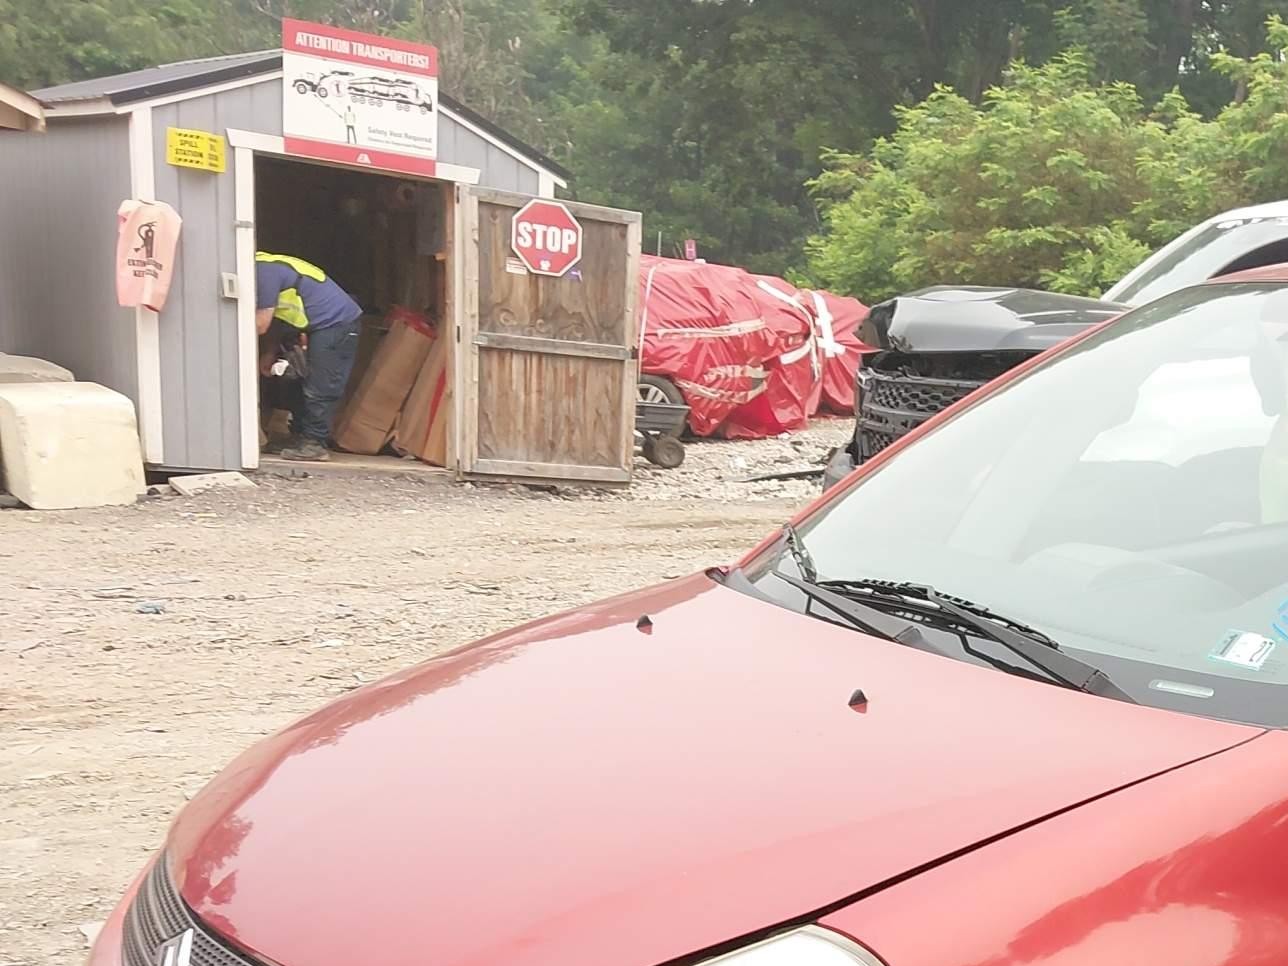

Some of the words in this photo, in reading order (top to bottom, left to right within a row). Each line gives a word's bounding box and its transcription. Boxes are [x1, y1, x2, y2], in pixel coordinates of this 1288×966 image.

[295, 31, 350, 54] ATTENTION
[351, 41, 430, 69] TRANSPORTERS!
[175, 148, 204, 158] STATION
[180, 139, 200, 148] SPILL
[517, 221, 577, 255] STOP
